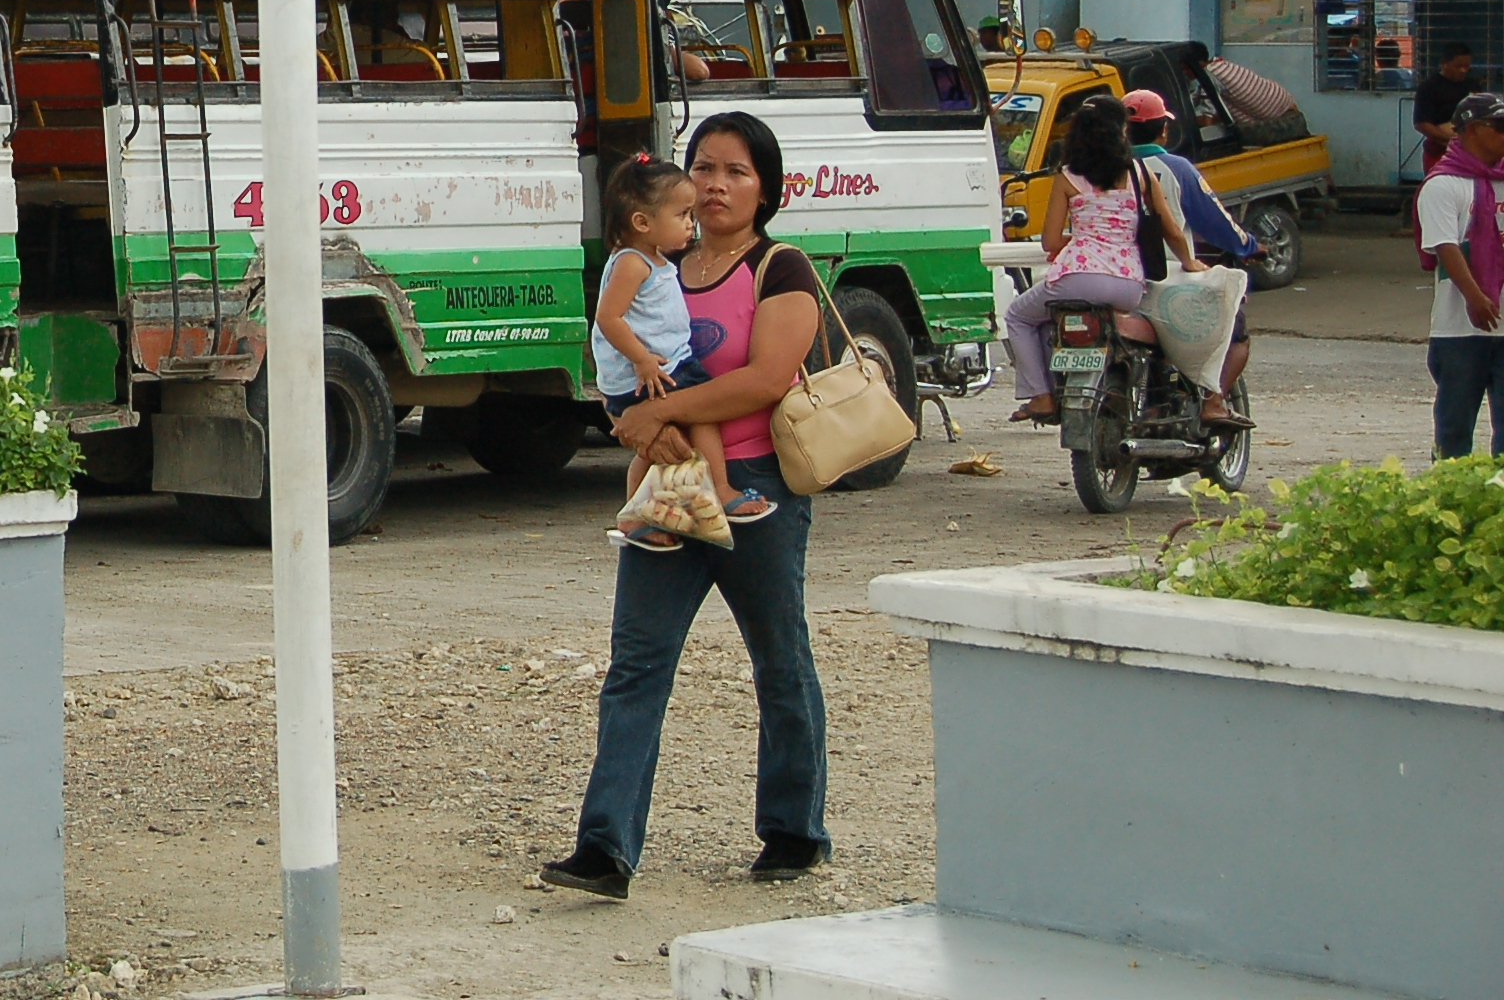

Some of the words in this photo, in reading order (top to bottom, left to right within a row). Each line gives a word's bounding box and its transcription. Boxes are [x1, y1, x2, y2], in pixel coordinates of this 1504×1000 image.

[812, 165, 879, 199] Lines
[234, 180, 361, 226] 43
[1071, 355, 1102, 368] 9489
